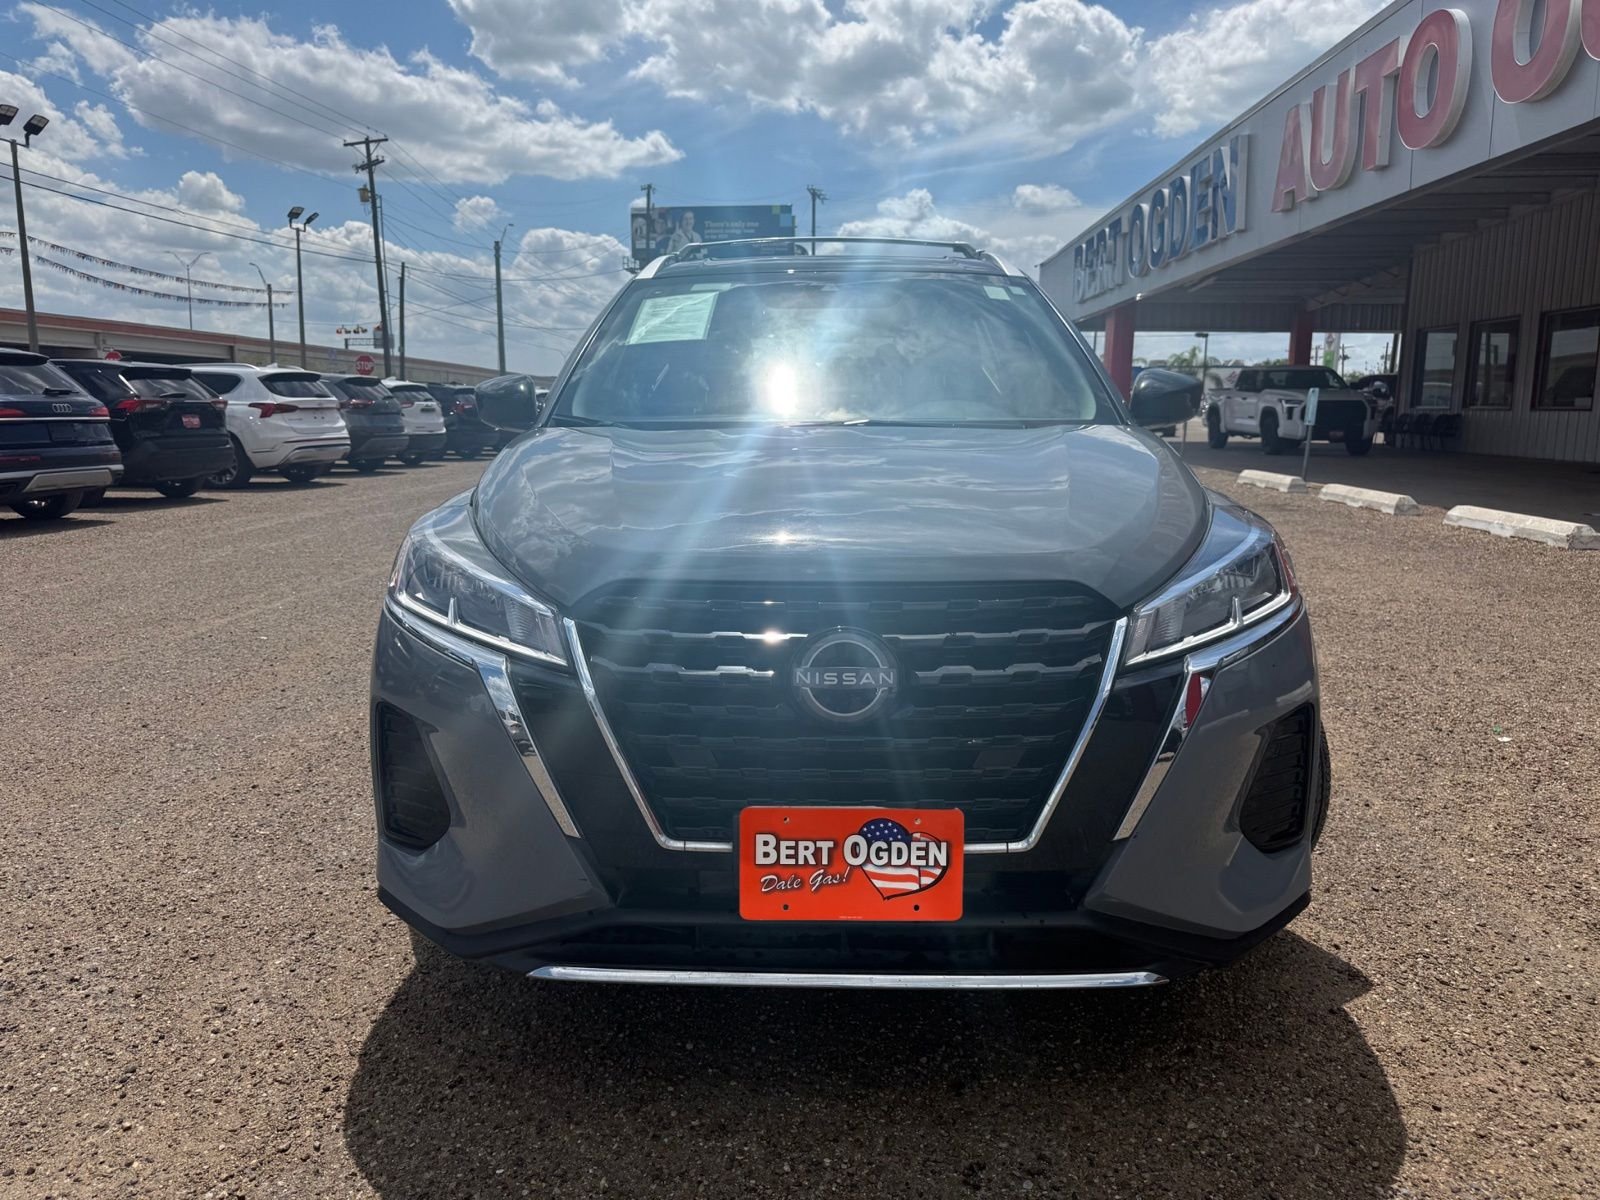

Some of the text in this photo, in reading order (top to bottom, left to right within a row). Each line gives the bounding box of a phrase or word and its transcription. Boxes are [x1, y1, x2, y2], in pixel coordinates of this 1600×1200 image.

[1073, 216, 1129, 303] BERT
[1128, 134, 1250, 279] OGDEN
[1272, 8, 1473, 213] AUTO
[356, 361, 374, 370] STOP
[796, 671, 894, 685] NISSAN
[755, 833, 947, 867] BERT OGDEN
[760, 865, 851, 893] Dale Gas!
